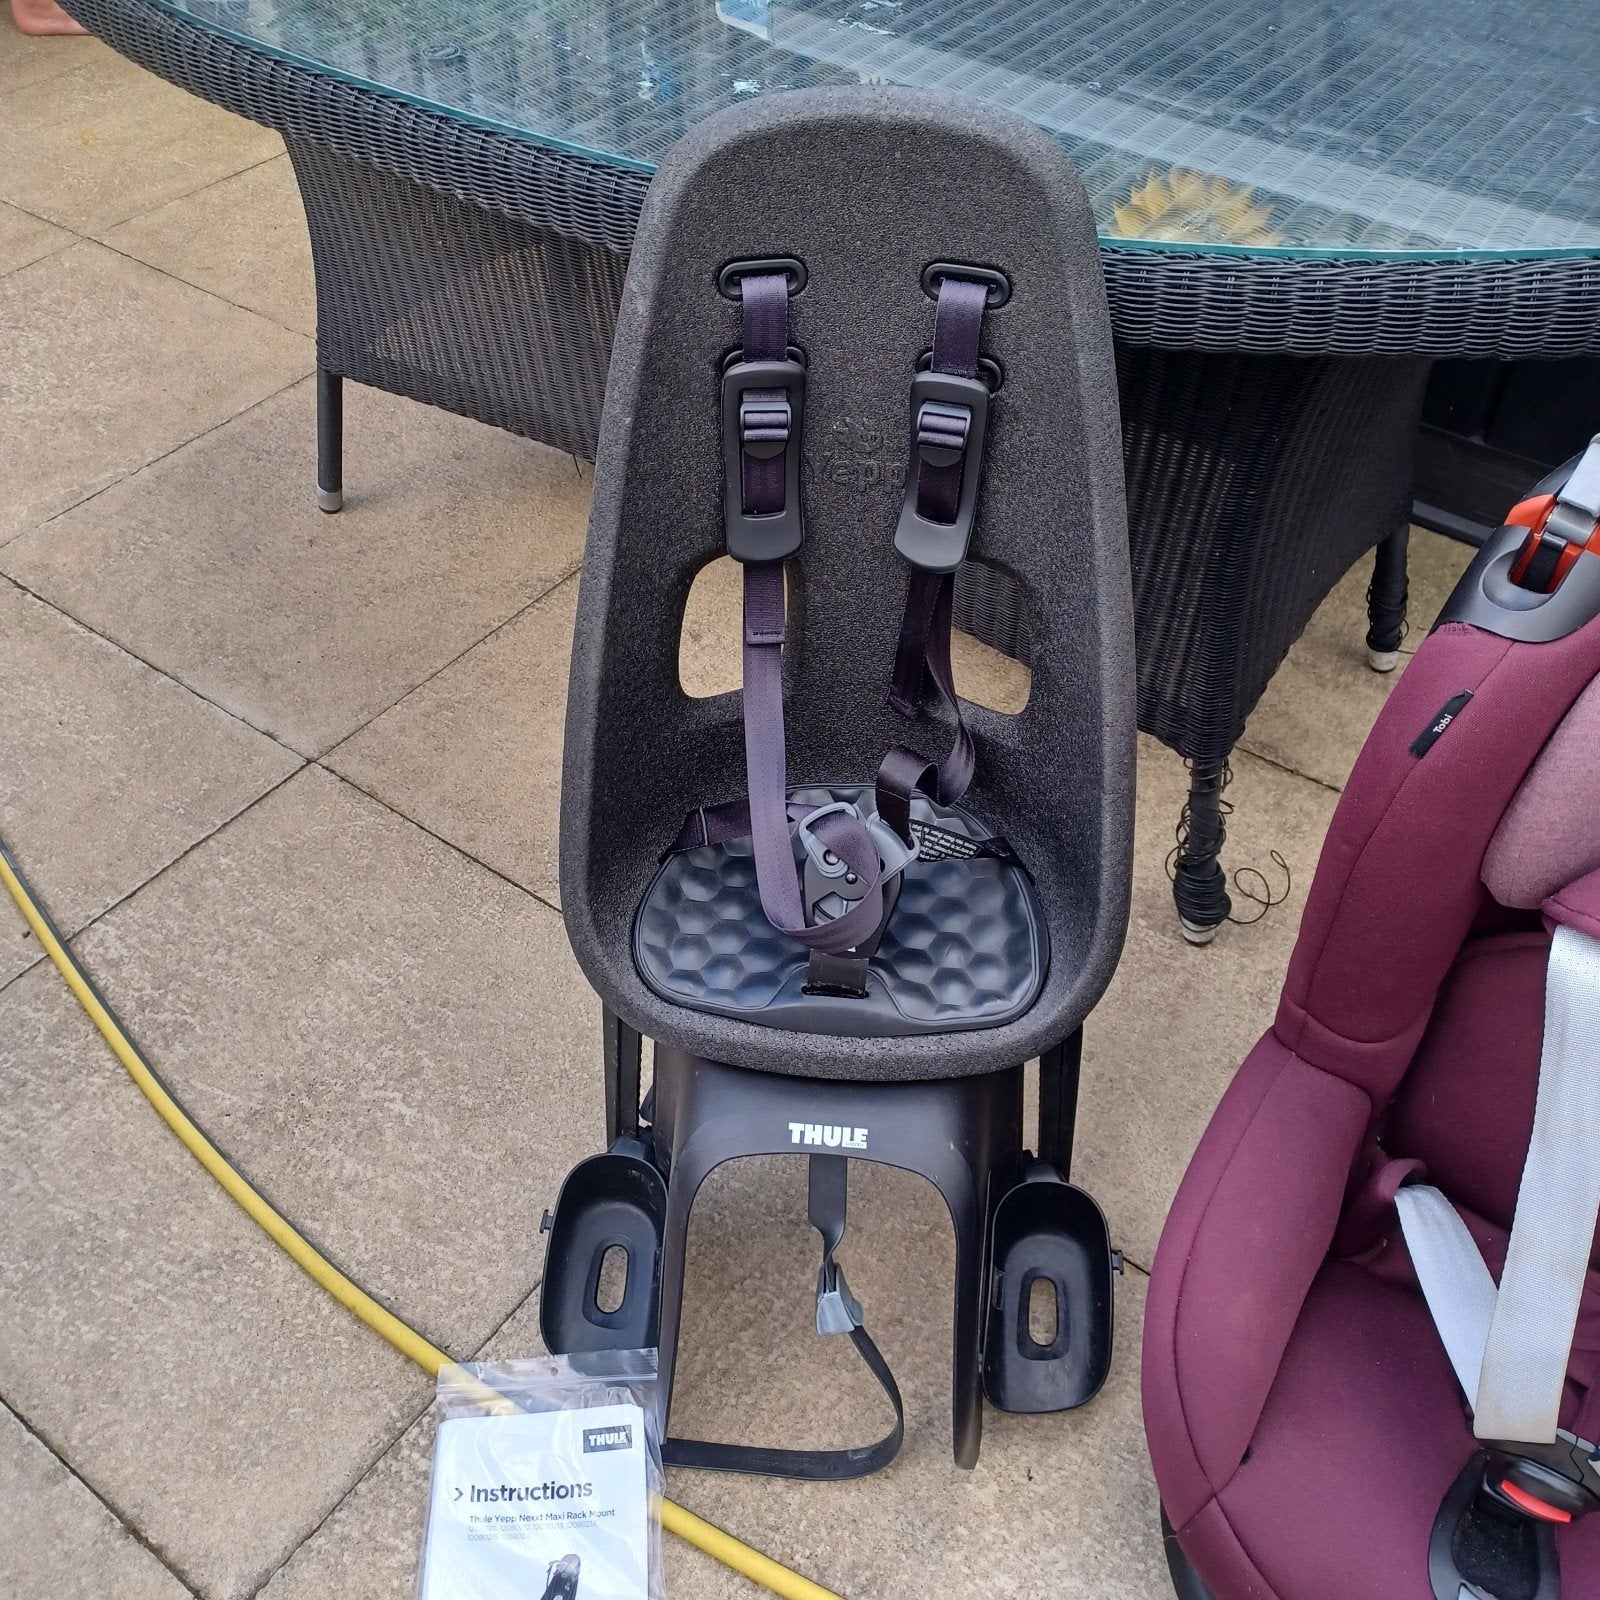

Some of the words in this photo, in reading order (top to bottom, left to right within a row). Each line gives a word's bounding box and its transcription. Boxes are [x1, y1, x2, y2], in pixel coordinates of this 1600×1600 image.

[803, 452, 907, 493] Yepp
[1432, 713, 1453, 733] Tobi
[788, 1122, 868, 1149] THULE
[588, 1431, 627, 1447] THULE
[470, 1480, 593, 1502] Instructions
[469, 1514, 492, 1523] Thule
[494, 1513, 517, 1523] Yepp
[545, 1511, 565, 1521] Maxi
[566, 1510, 587, 1520] Rack
[589, 1508, 615, 1518] Mount
